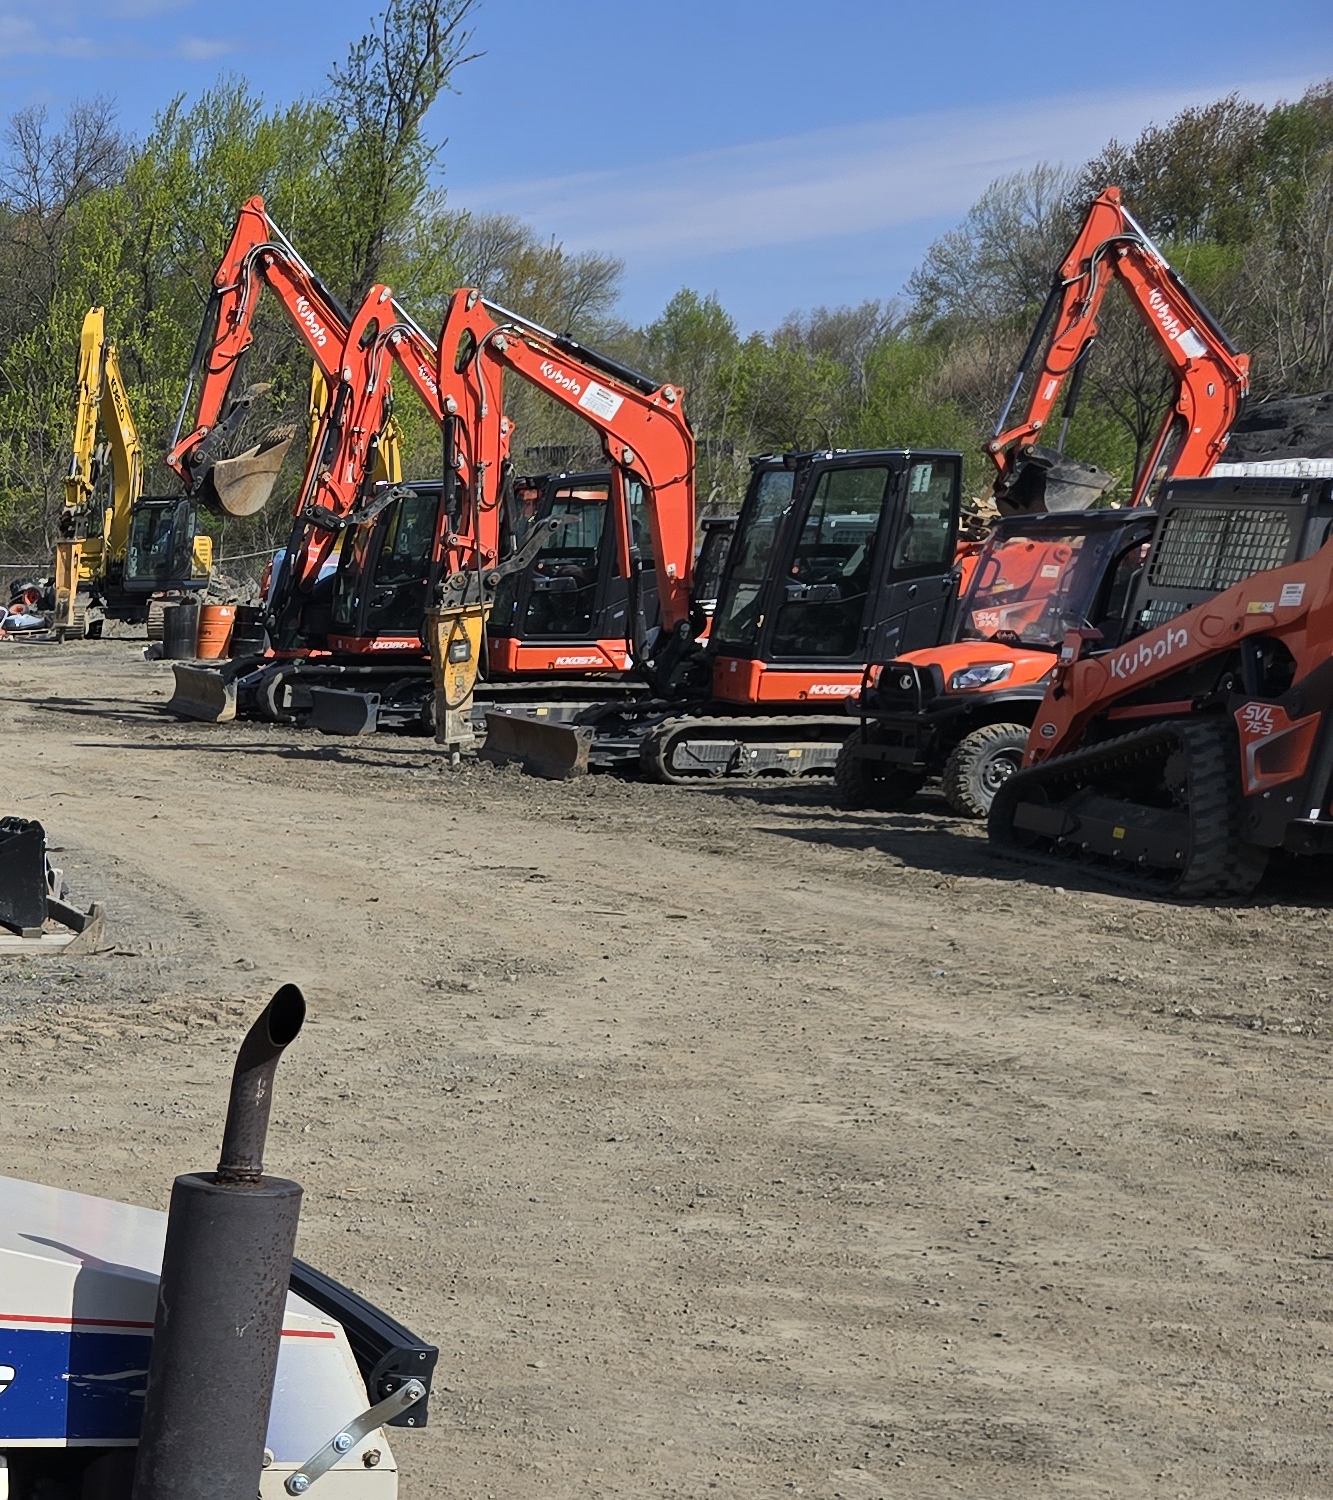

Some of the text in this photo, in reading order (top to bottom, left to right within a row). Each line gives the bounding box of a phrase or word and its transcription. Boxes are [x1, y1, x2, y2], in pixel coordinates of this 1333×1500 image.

[296, 295, 327, 347] Kubota
[1149, 288, 1180, 340] Kubota
[540, 361, 581, 395] Kubota
[1111, 628, 1188, 679] Kubota
[1241, 705, 1274, 723] SVL
[1243, 721, 1273, 735] 75-3
